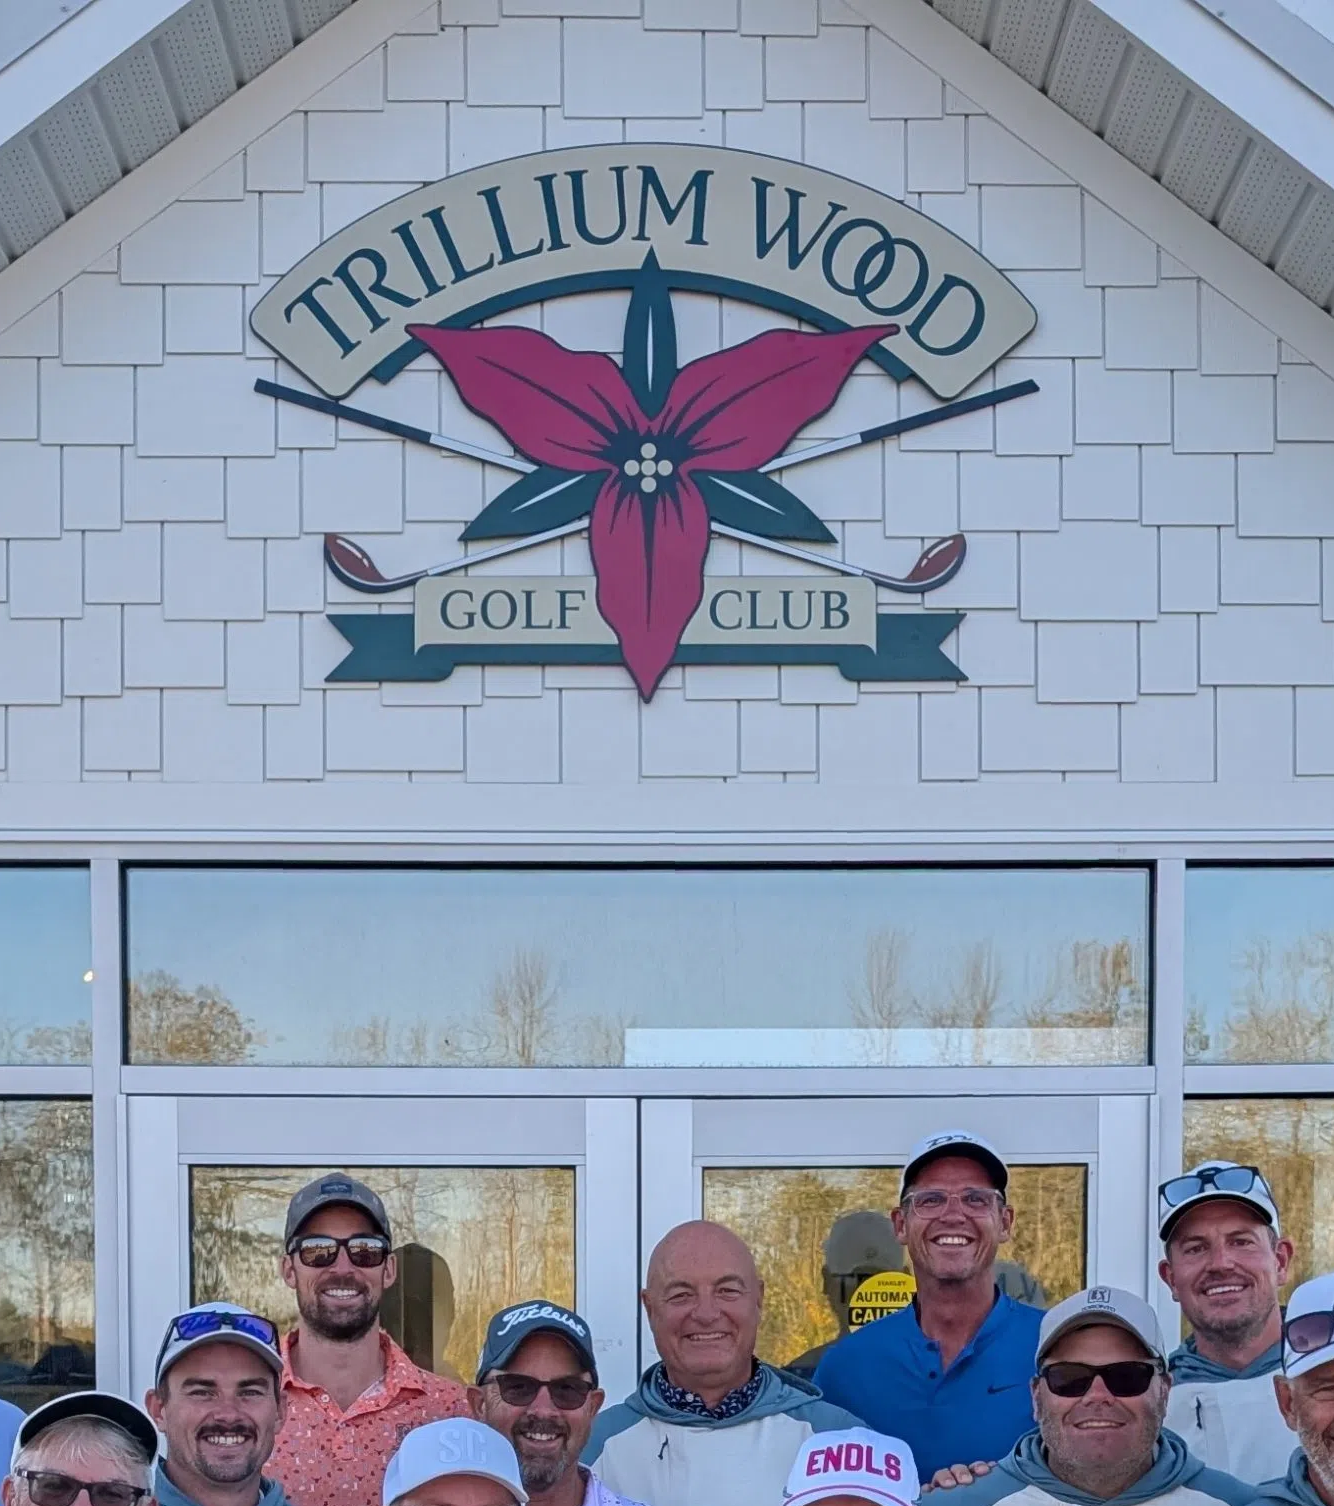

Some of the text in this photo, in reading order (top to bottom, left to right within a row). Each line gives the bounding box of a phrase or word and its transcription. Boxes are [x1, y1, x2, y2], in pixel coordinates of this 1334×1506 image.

[283, 164, 987, 361] TRILLIUM WOOD
[438, 588, 851, 632] GOLF CLUB
[497, 1304, 586, 1337] Titleist
[805, 1443, 901, 1481] ENDLS
